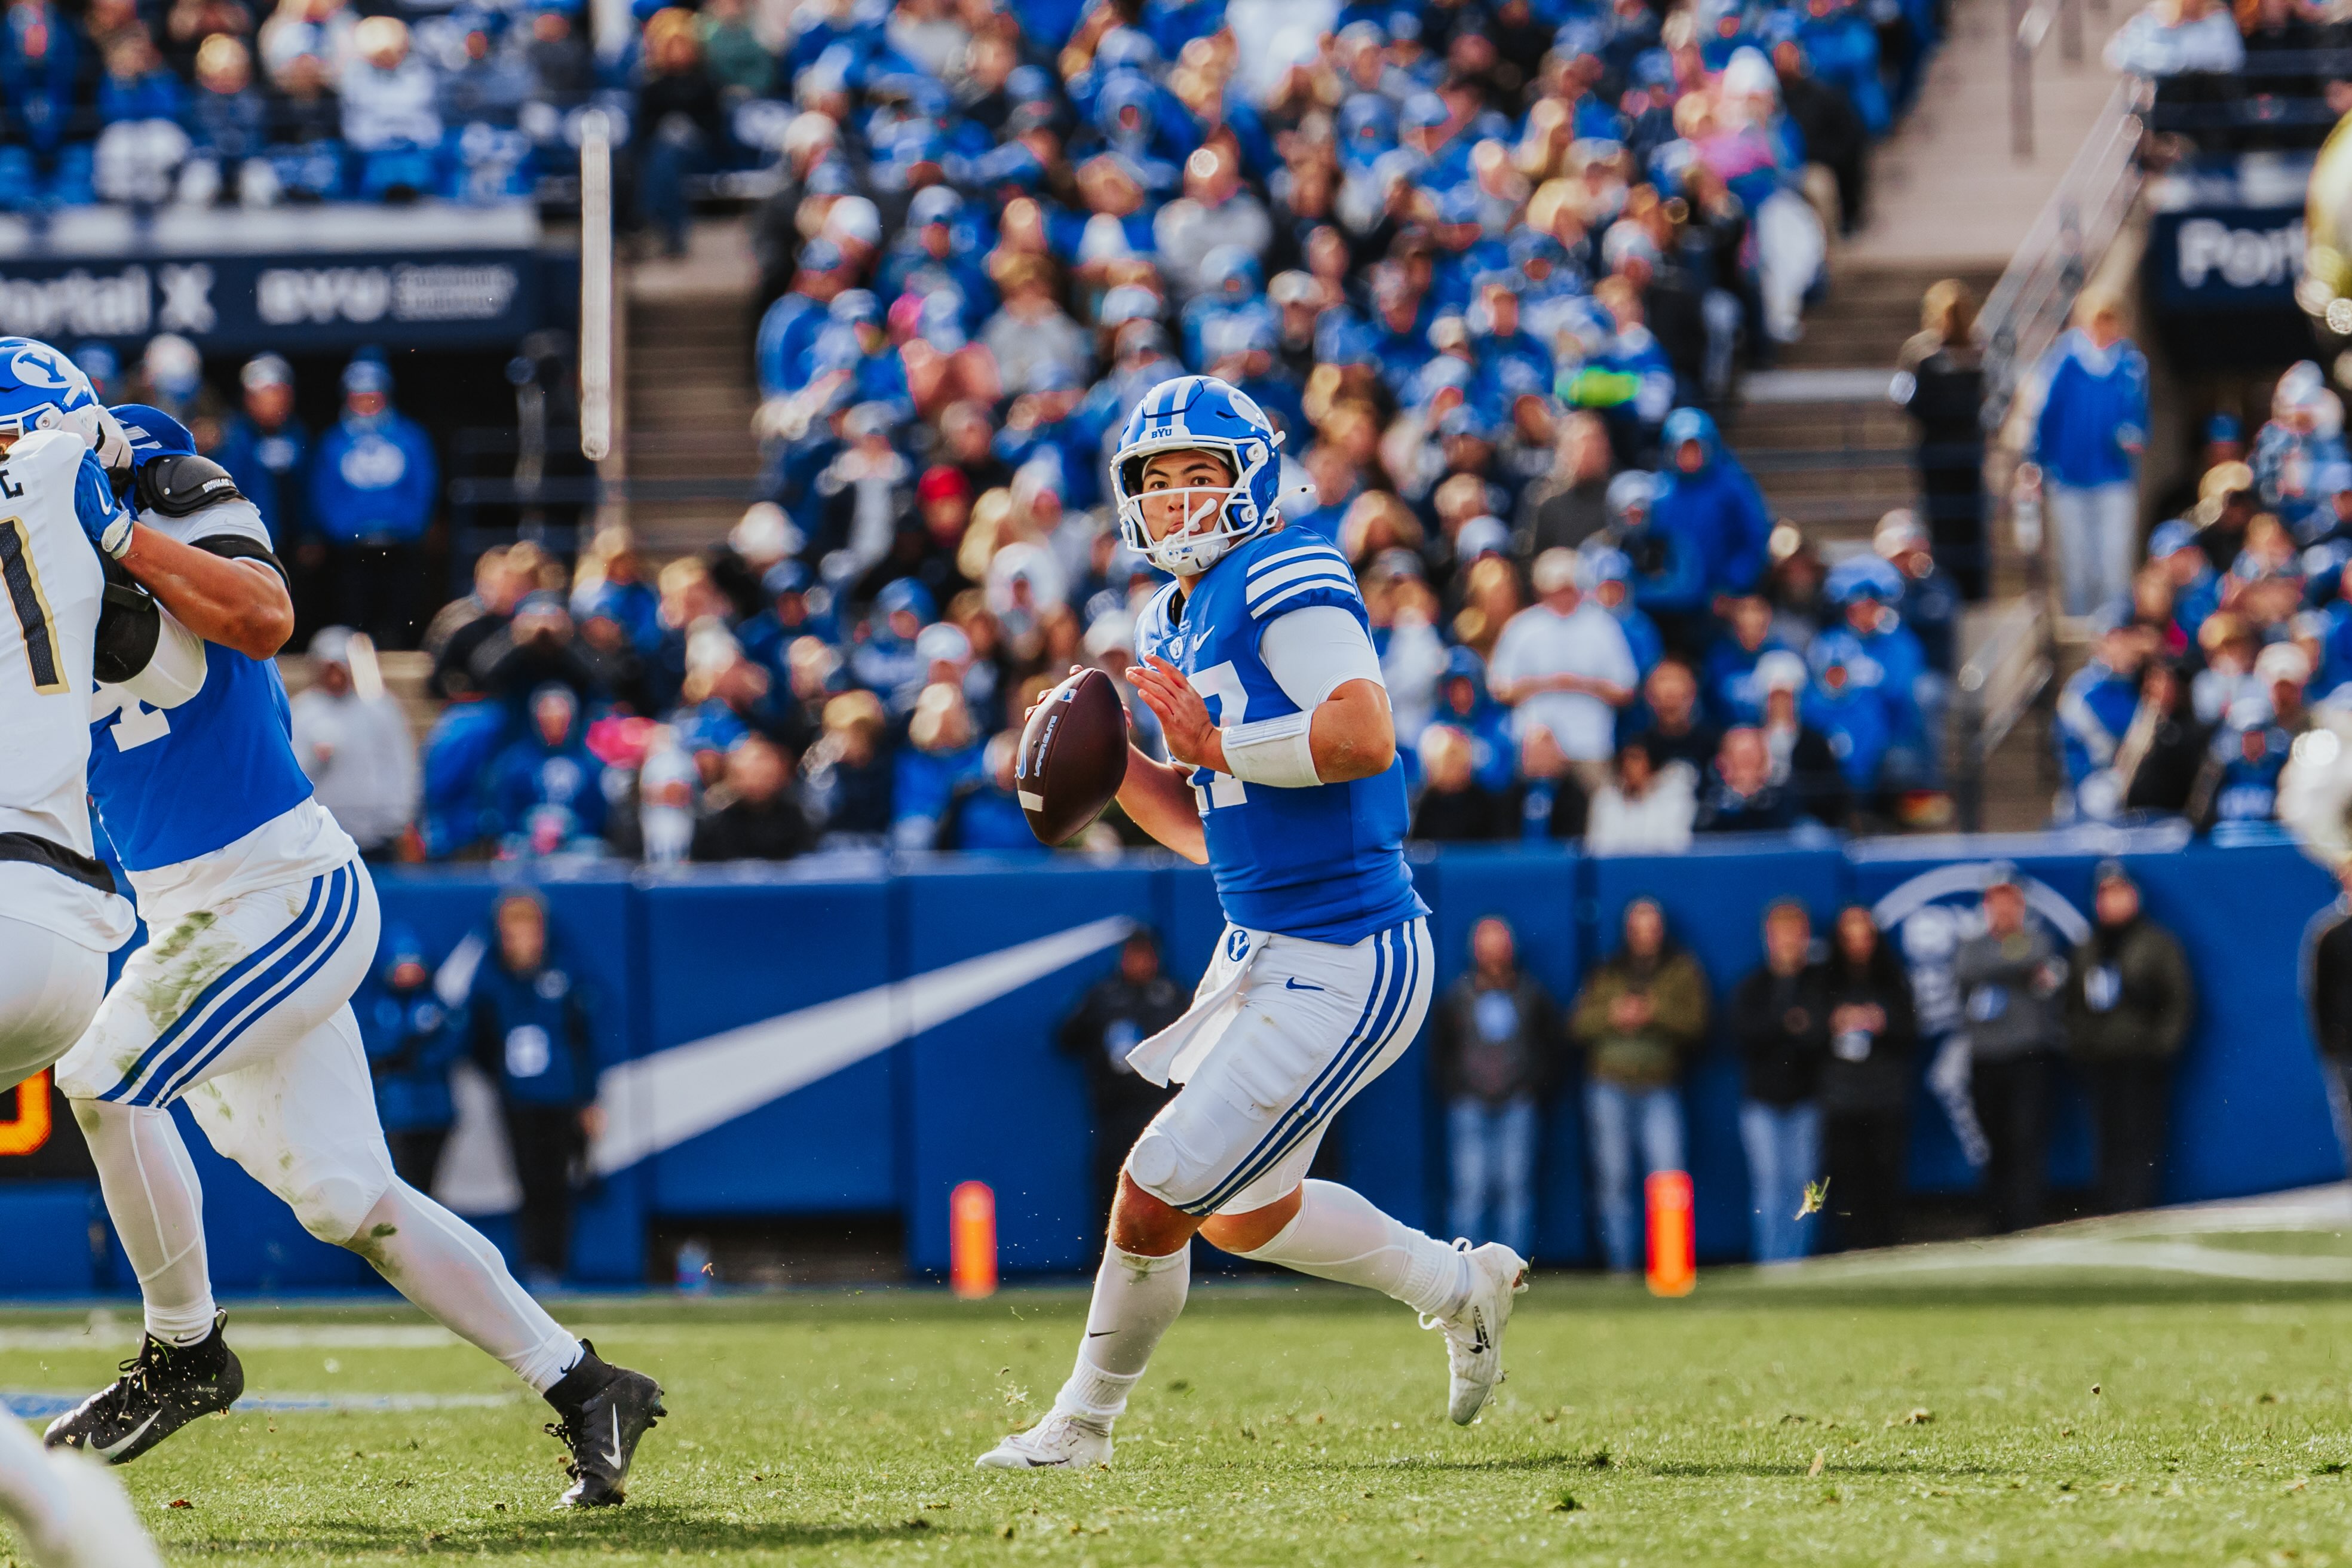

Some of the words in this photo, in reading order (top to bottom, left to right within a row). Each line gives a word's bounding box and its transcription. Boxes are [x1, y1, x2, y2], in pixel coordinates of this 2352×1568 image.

[0, 263, 151, 336] ortal
[1151, 428, 1172, 438] BYU
[202, 478, 230, 493] DOUGLAS
[1042, 715, 1058, 744] ELITE
